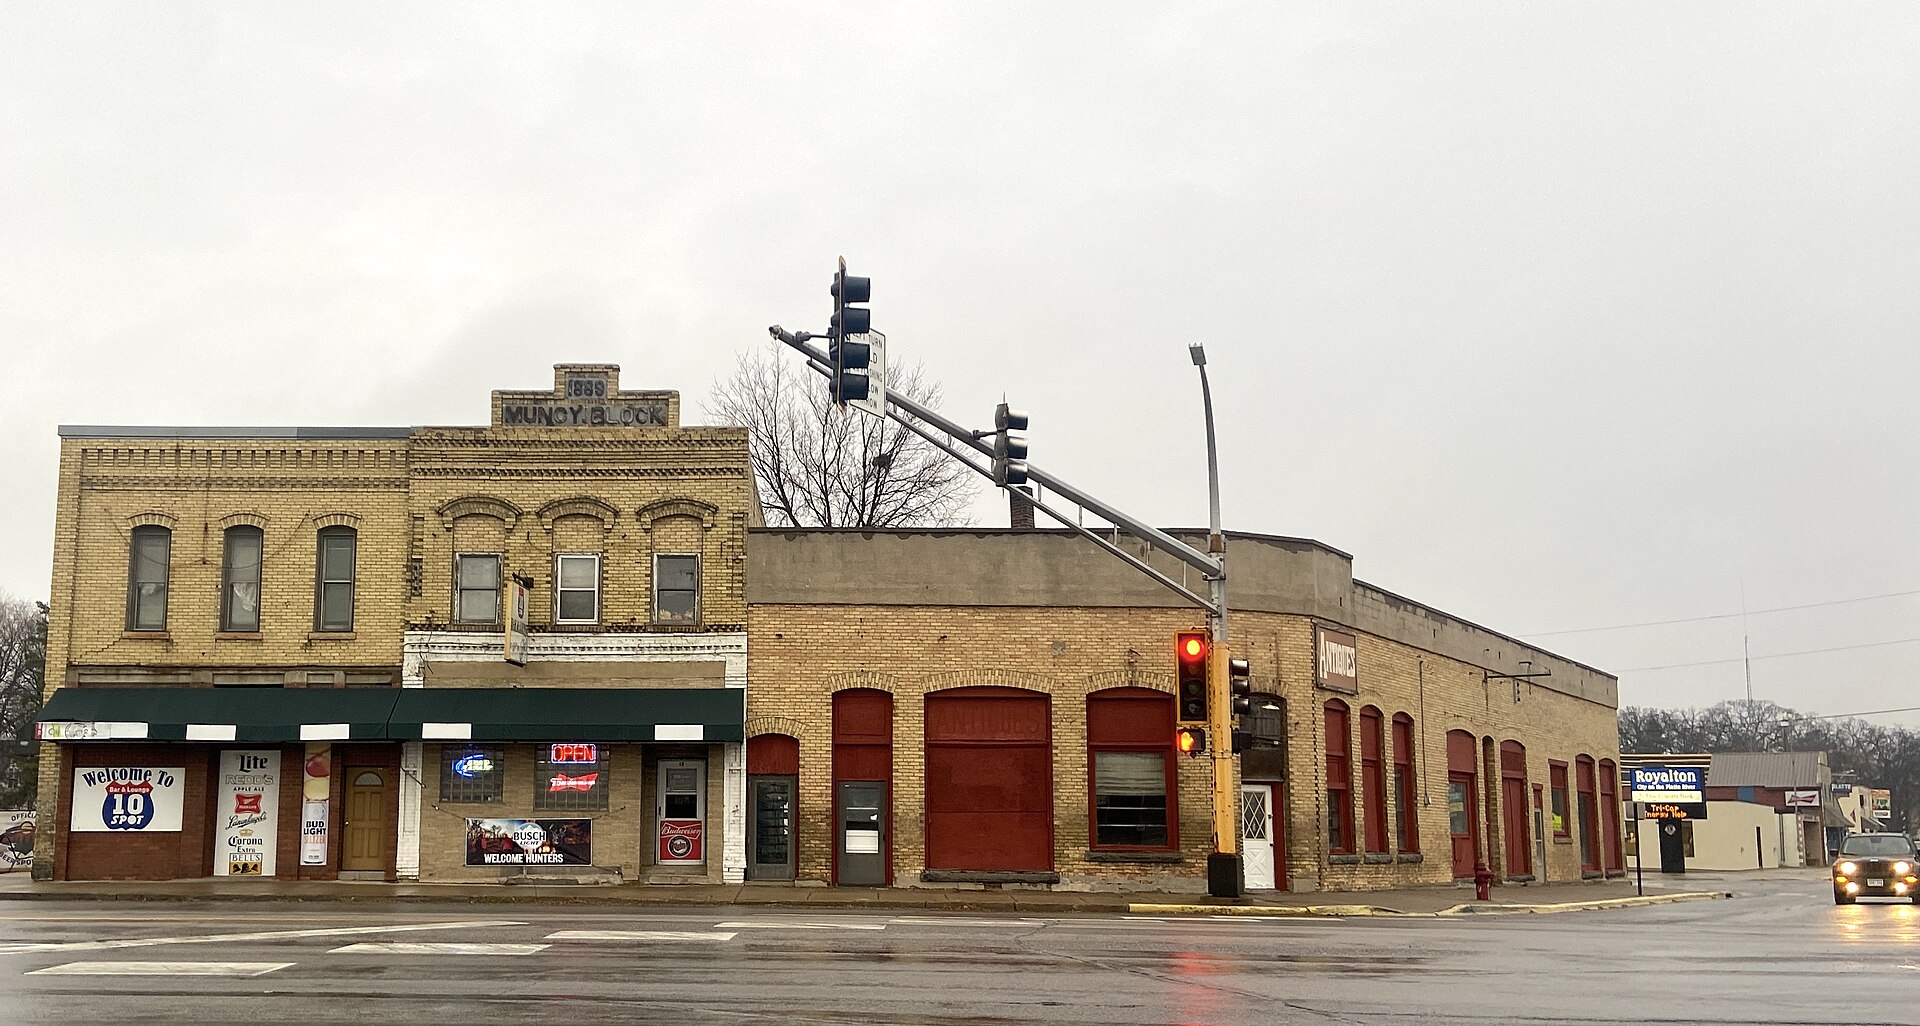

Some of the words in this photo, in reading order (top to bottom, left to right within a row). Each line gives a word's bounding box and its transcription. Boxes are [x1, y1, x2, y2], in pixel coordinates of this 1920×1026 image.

[567, 379, 605, 397] 1889
[590, 406, 668, 426] BLOCK
[553, 745, 594, 762] OPEN
[239, 754, 269, 773] Lite
[82, 767, 152, 787] Welcome
[156, 770, 175, 788] To
[225, 773, 274, 785] REDD'S
[1634, 769, 1697, 785] Royalton
[127, 786, 150, 794] Lounge
[112, 794, 144, 815] 10
[110, 815, 145, 825] SPOT
[228, 835, 263, 848] Corona
[513, 831, 547, 841] BUSCH
[232, 854, 261, 862] BELL'S
[484, 853, 524, 864] WELCOME
[525, 853, 564, 864] HUNTERS
